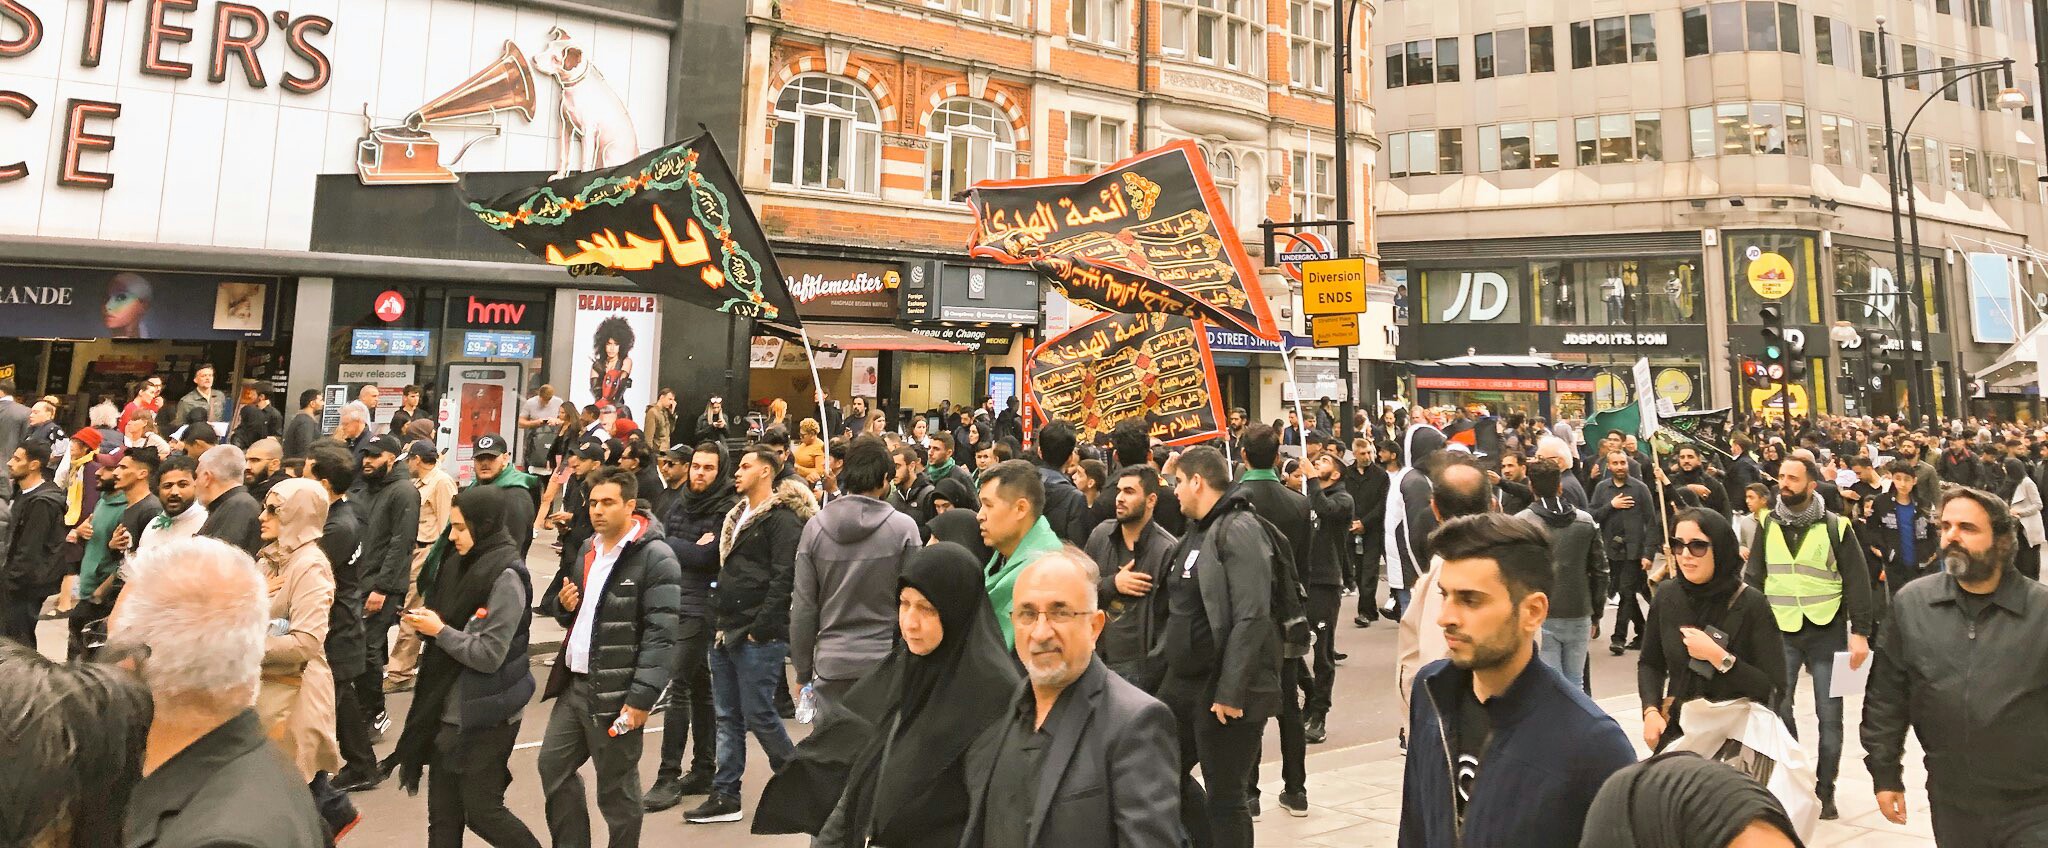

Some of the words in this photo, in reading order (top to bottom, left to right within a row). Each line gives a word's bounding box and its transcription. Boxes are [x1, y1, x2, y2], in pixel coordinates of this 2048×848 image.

[1309, 271, 1360, 283] Diversion
[1319, 292, 1352, 303] ENDS
[1443, 272, 1508, 321] JD
[1864, 266, 1895, 318] JD
[467, 296, 527, 324] hmv
[578, 294, 645, 313] DEADPOOL
[645, 294, 656, 313] 2
[942, 329, 954, 338] de
[956, 329, 986, 339] Change
[1217, 332, 1248, 346] STREET
[1562, 333, 1668, 346] JDSPORTS.COM
[366, 369, 406, 378] releases
